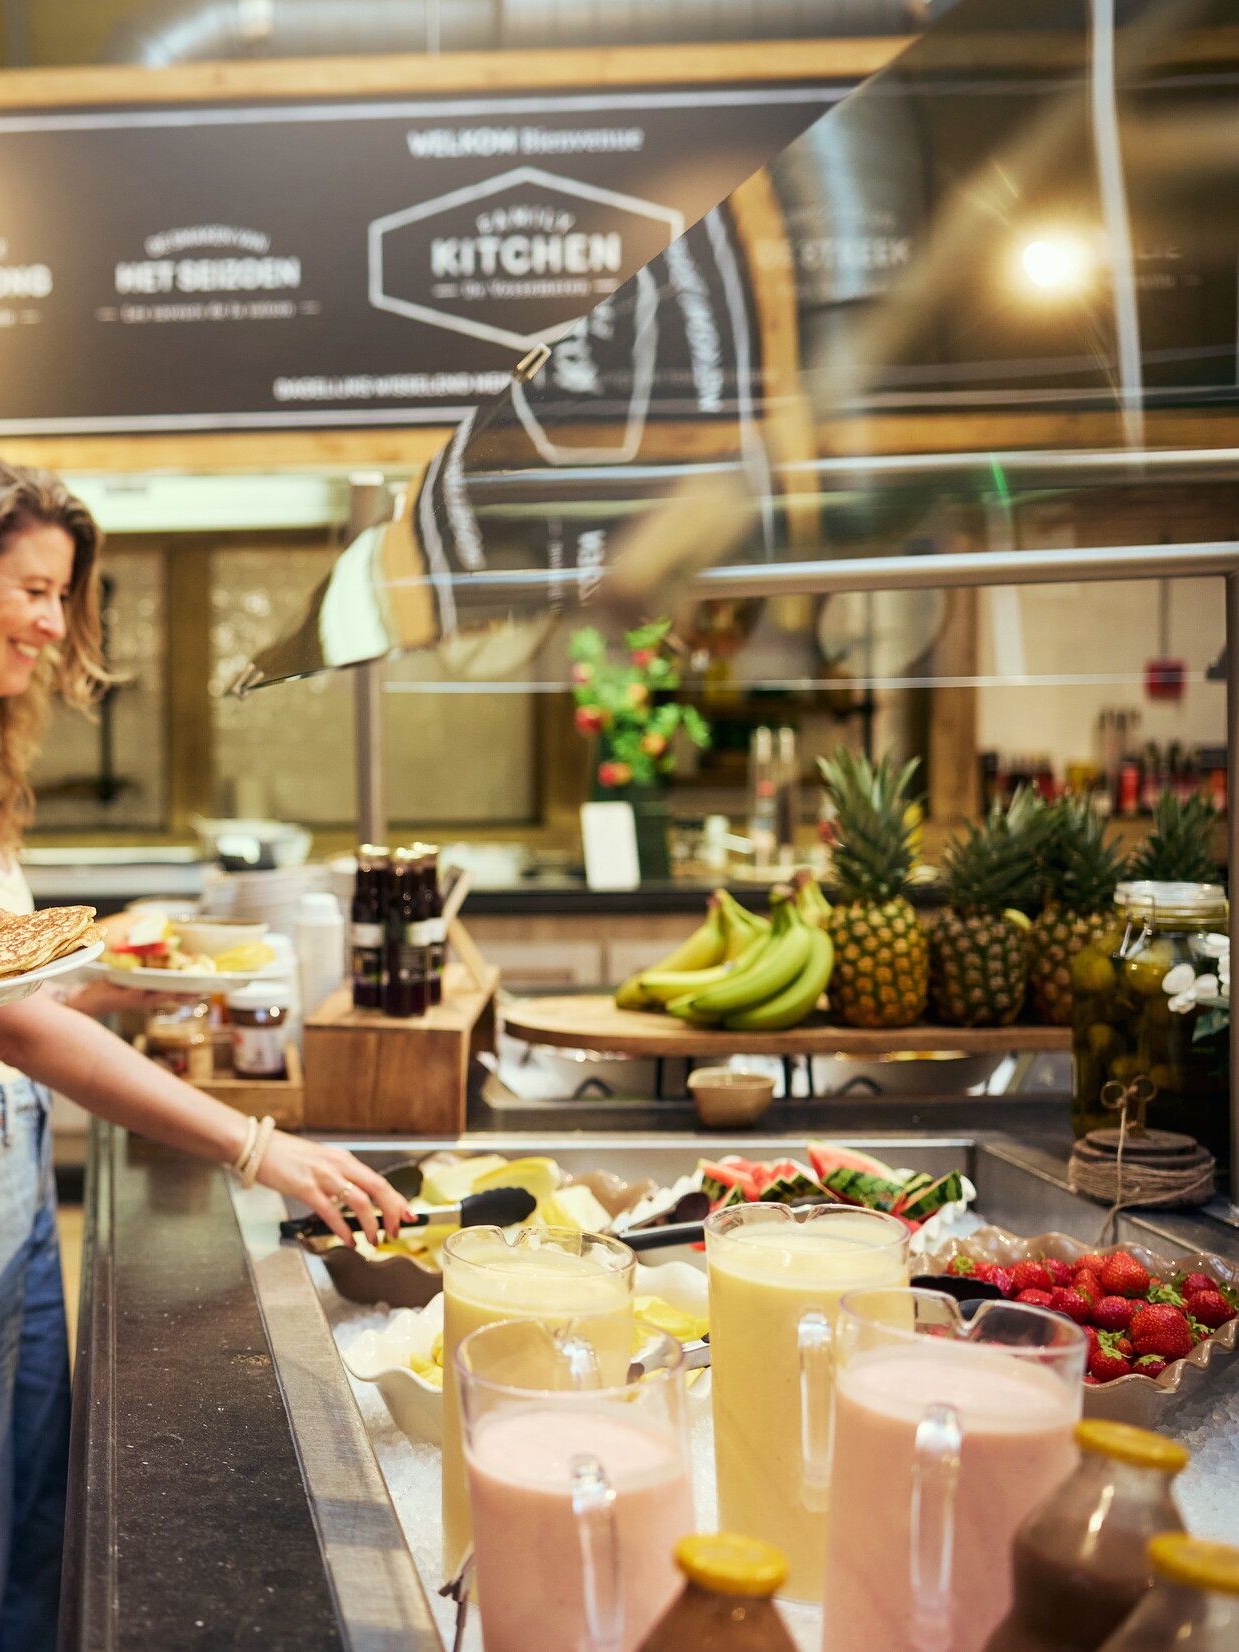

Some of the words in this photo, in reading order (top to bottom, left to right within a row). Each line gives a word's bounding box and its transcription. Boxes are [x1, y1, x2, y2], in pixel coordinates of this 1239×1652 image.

[407, 129, 518, 158] WELKOM
[476, 205, 576, 234] FAMILY
[431, 233, 622, 277] KITCHEN
[115, 260, 174, 294] HET
[175, 255, 301, 292] SEIZOEN
